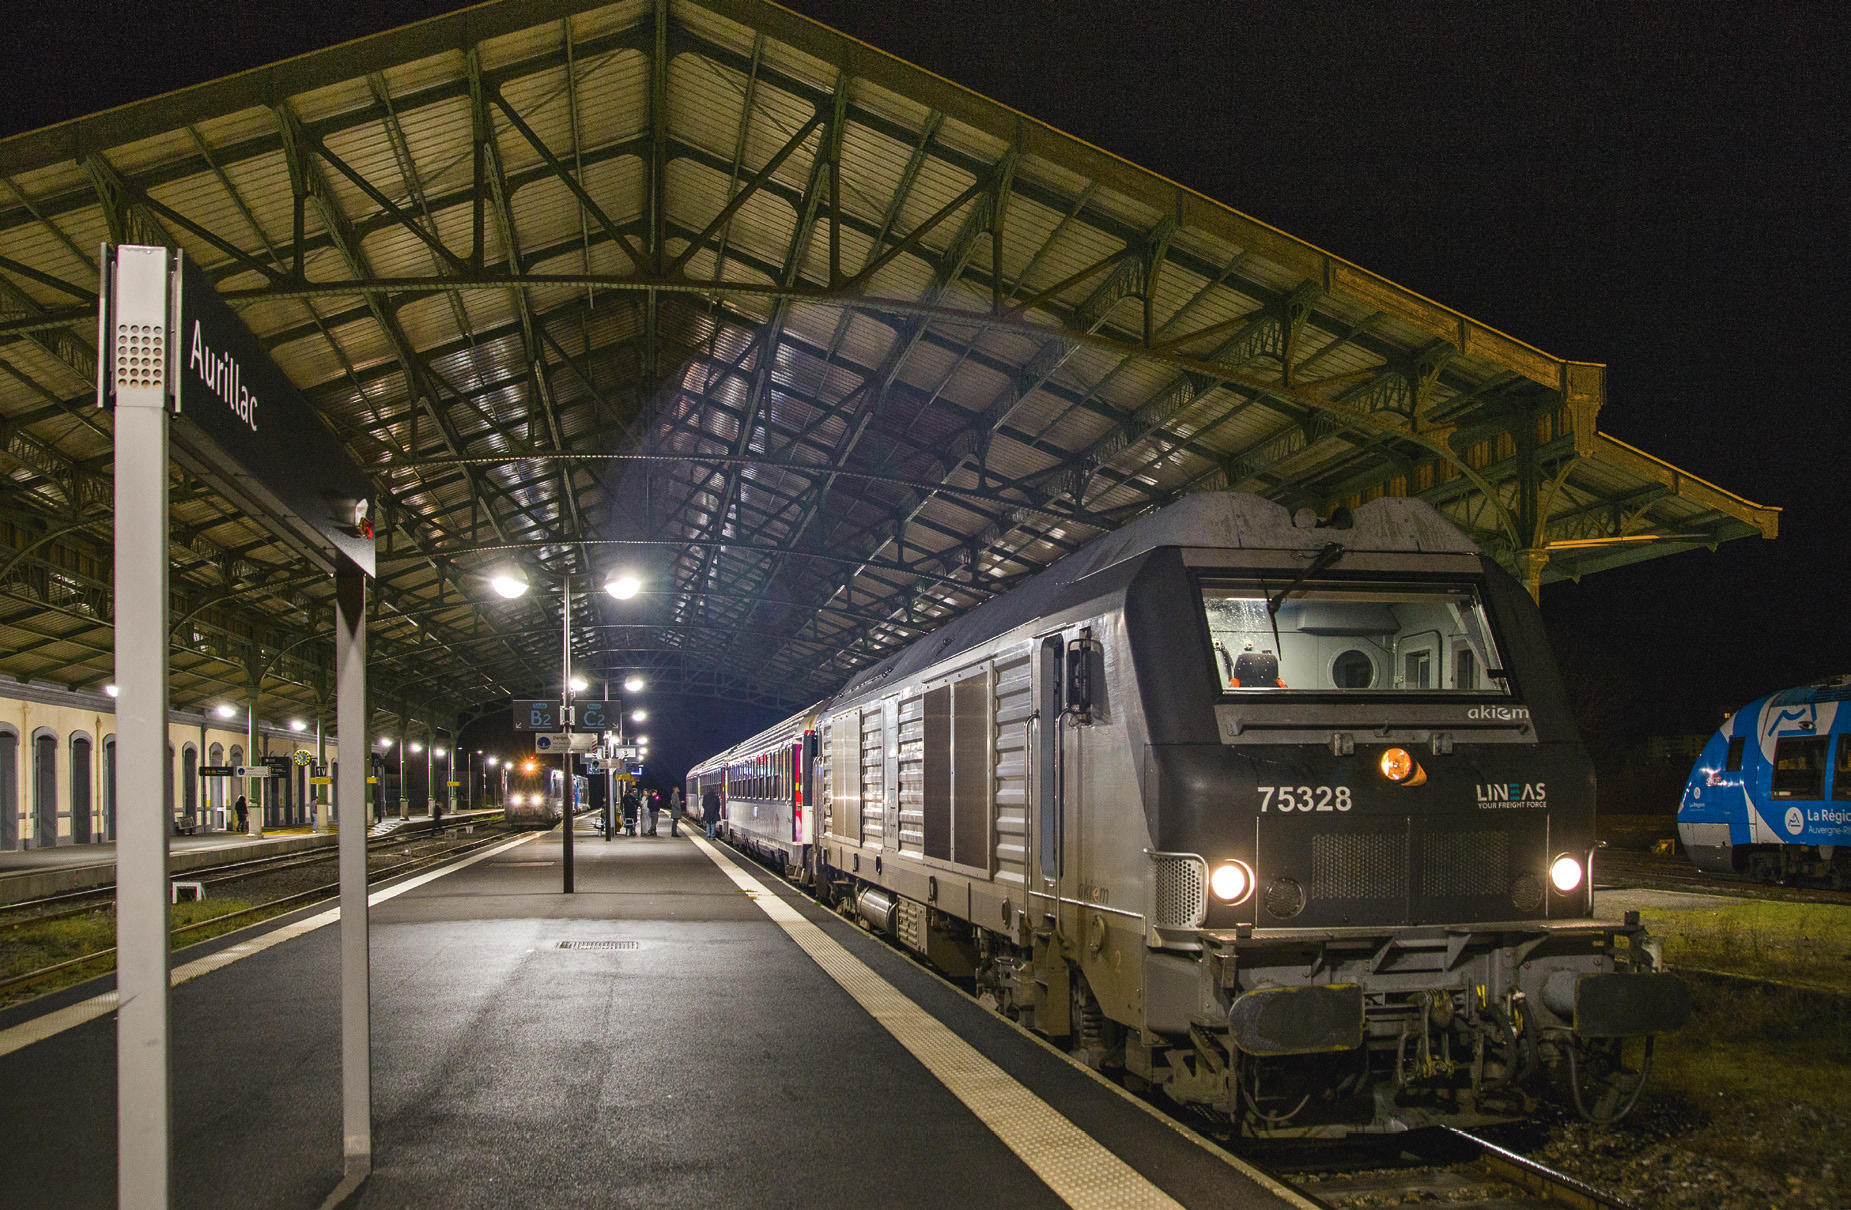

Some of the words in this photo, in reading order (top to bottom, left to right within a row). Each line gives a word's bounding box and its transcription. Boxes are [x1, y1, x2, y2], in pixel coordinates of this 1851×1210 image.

[190, 319, 258, 432] Aurillac
[530, 710, 551, 726] B2
[583, 710, 606, 726] C2
[1467, 704, 1529, 720] akiem
[1257, 786, 1352, 812] 75328
[1476, 783, 1546, 801] LINEAS
[1807, 809, 1820, 821] La
